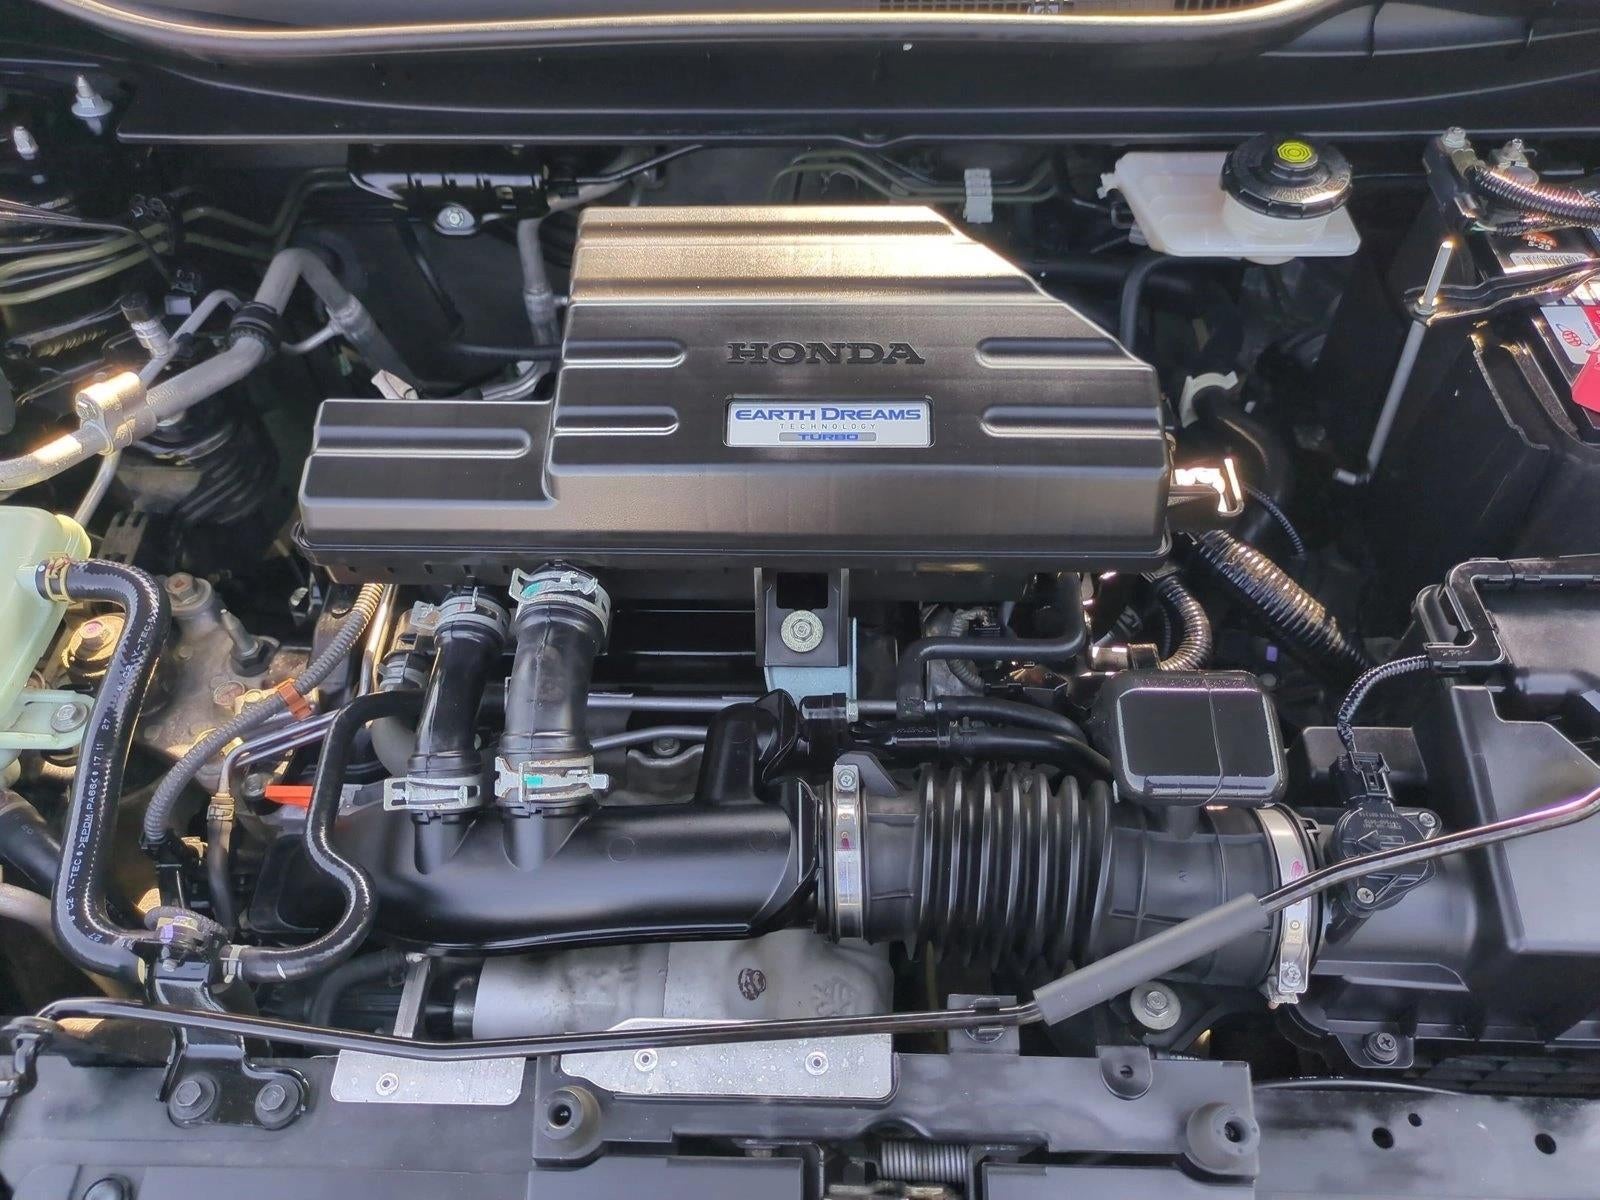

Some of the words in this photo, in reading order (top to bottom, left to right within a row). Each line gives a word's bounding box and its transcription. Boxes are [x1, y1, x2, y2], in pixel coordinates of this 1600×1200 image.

[727, 341, 926, 364] HONDA
[735, 409, 816, 421] EARTH
[820, 407, 922, 421] DREAMS
[799, 433, 859, 441] TURBO
[67, 858, 82, 892] Y-TEC
[101, 718, 111, 730] 27
